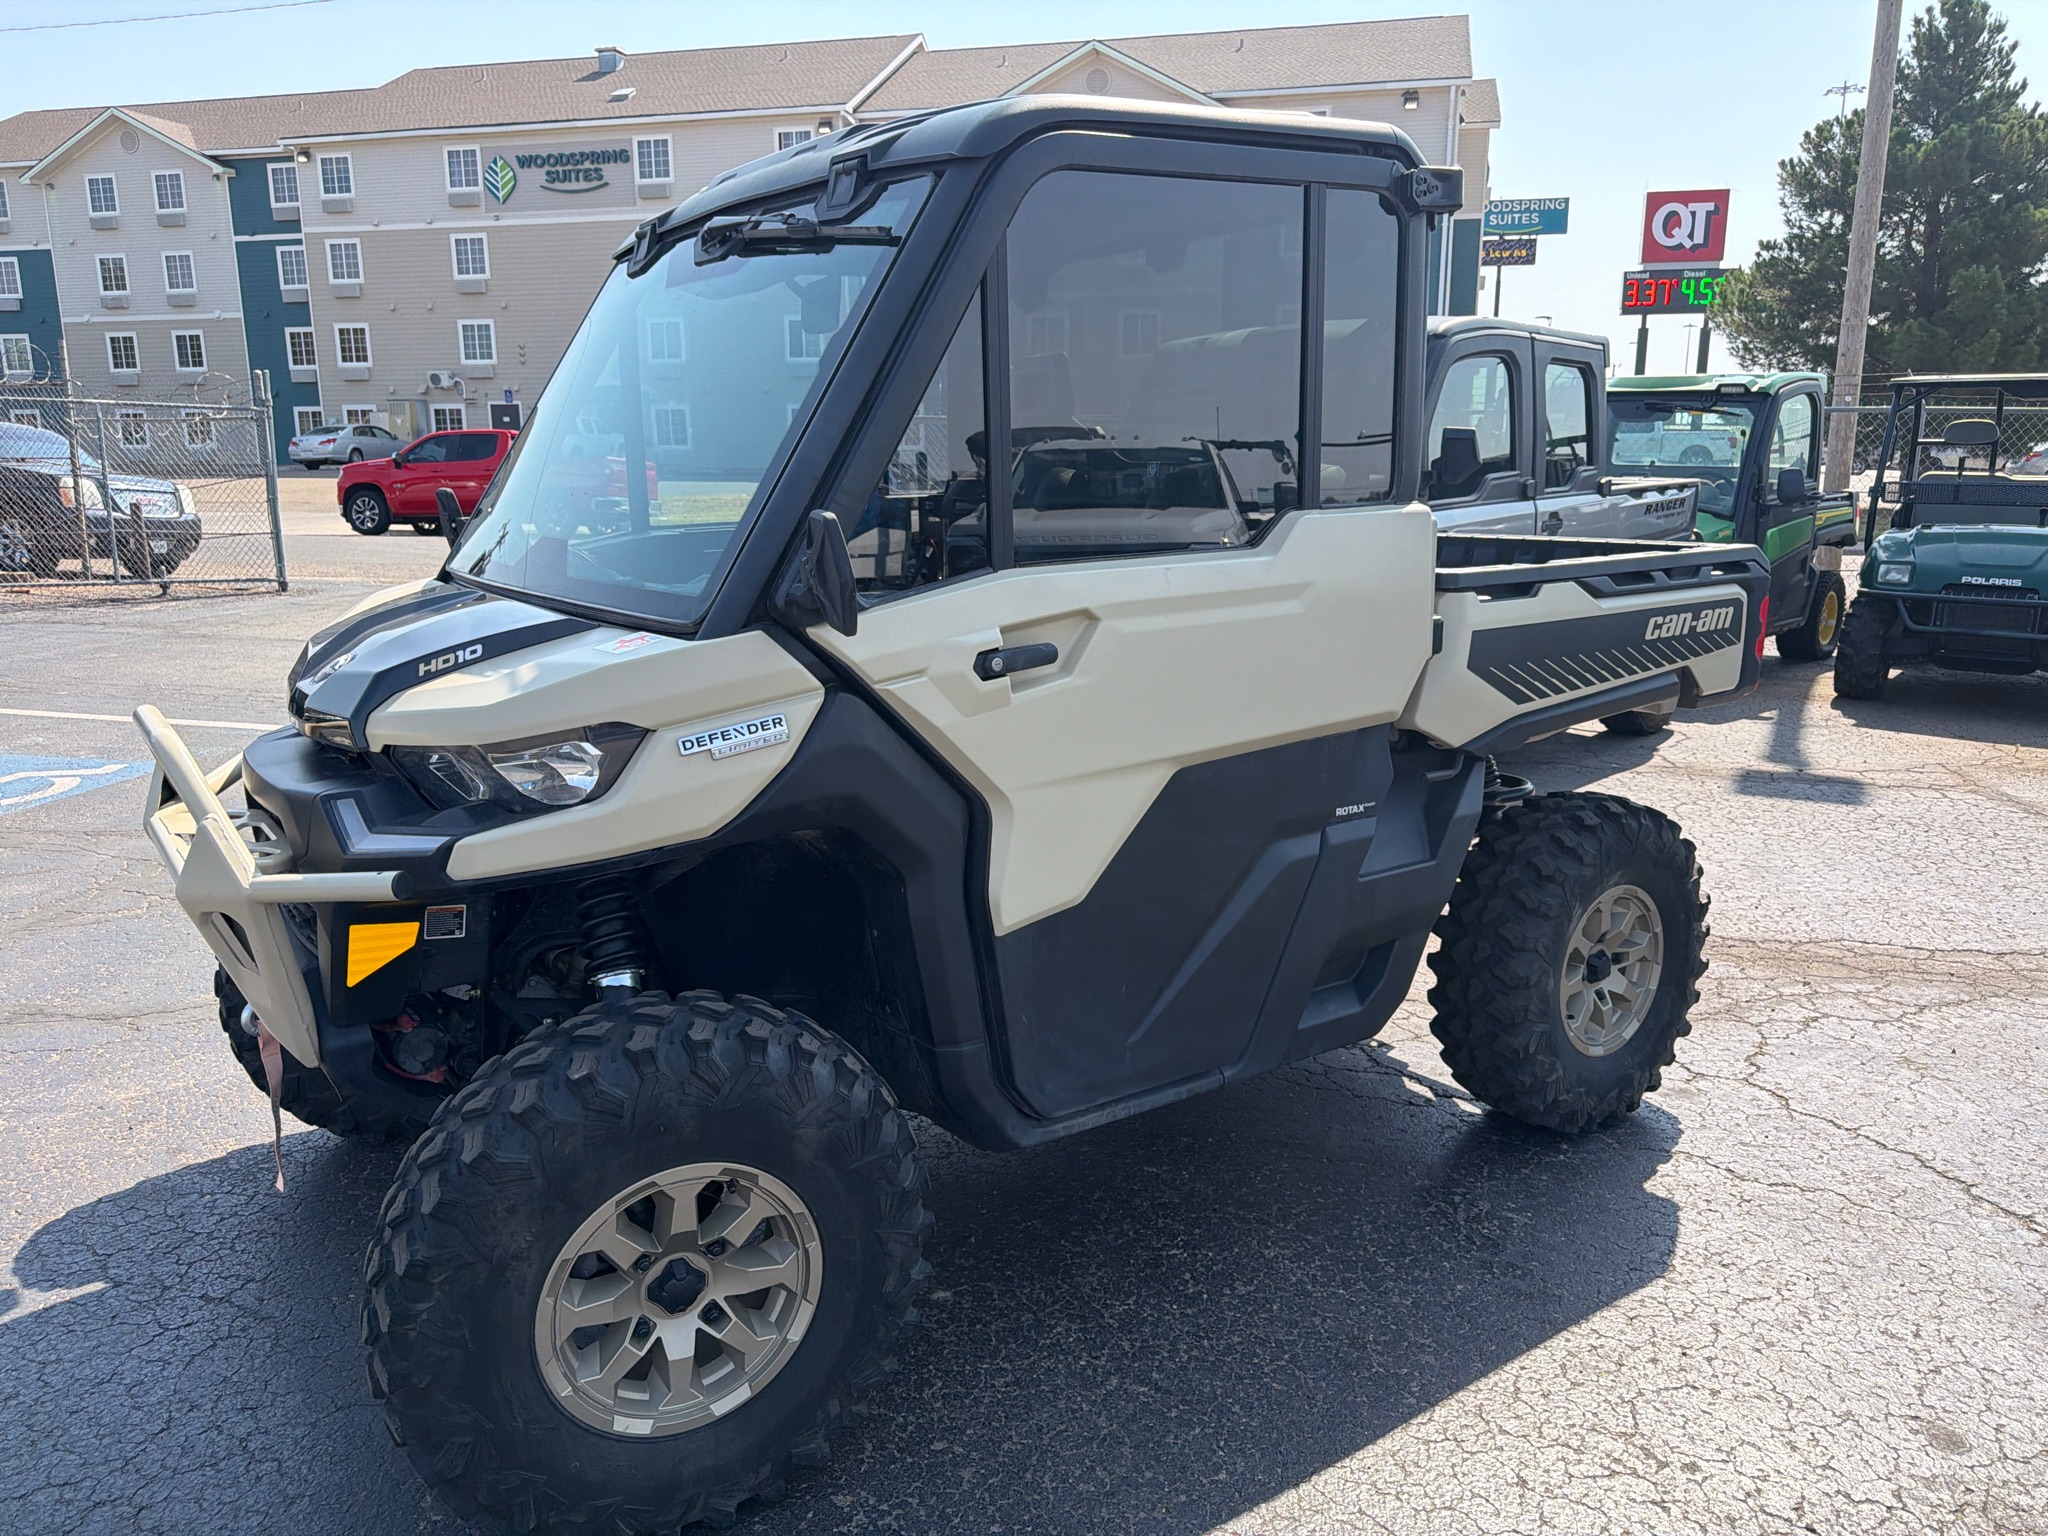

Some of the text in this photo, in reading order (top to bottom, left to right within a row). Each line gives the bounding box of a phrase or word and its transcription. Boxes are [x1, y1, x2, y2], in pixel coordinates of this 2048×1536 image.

[515, 149, 630, 169] WOODSPRING
[545, 167, 604, 184] SUITES
[1489, 213, 1540, 226] SUITES
[1652, 202, 1715, 249] QT
[1626, 271, 1650, 279] Unlead
[1683, 270, 1706, 278] Diesel
[1644, 498, 1687, 516] RANGER
[1961, 575, 2023, 587] POLARIS
[418, 643, 483, 677] HD10
[681, 716, 784, 752] DEFENDER
[718, 734, 783, 755] LIMITED
[1335, 804, 1364, 817] ROTAX
